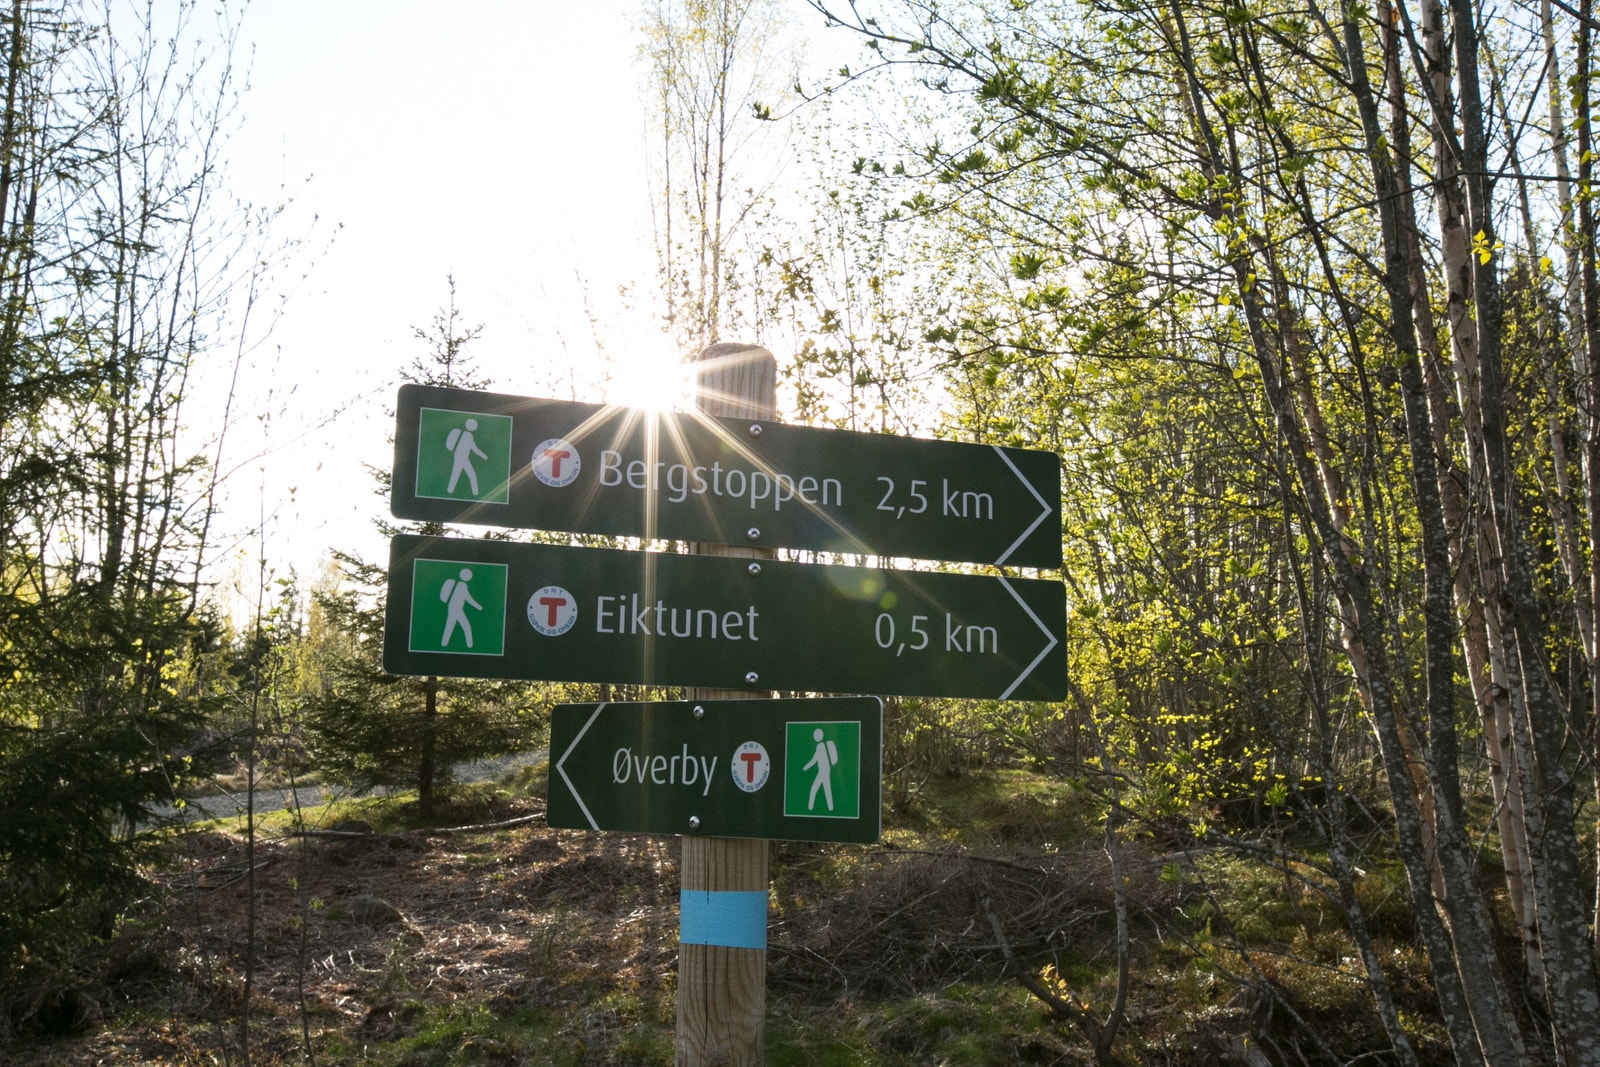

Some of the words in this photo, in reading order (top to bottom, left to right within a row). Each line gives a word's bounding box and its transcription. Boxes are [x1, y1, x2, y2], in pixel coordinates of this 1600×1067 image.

[599, 450, 842, 511] Bergstoppen
[876, 476, 928, 519] 2,5
[943, 478, 993, 520] km
[596, 593, 759, 641] Eiktunet
[875, 612, 929, 657] 0,5
[946, 612, 998, 654] km
[612, 743, 718, 797] Øverby
